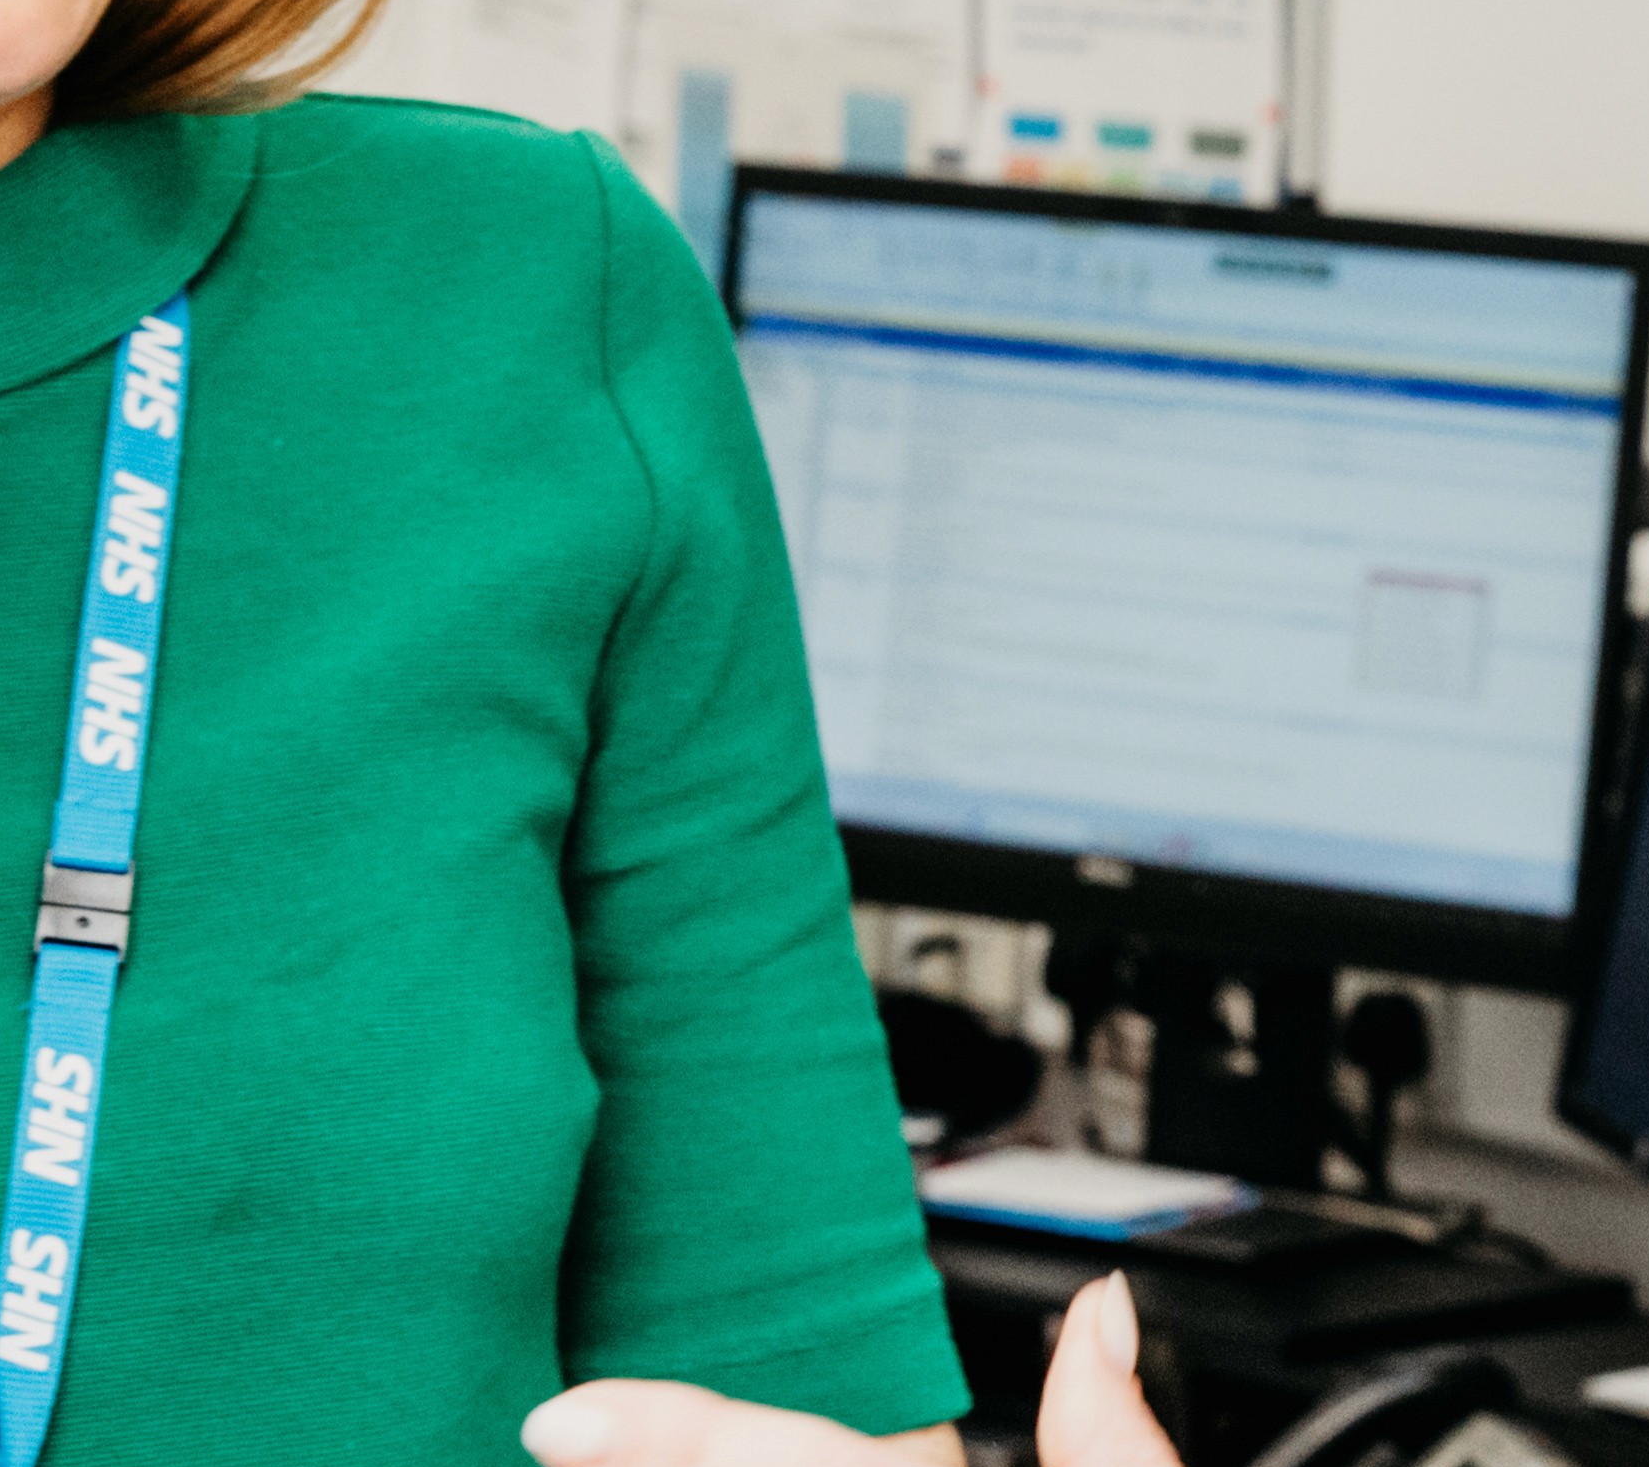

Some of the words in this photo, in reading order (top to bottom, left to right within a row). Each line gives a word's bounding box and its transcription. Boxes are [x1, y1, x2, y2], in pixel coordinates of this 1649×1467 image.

[122, 315, 183, 439] NHS
[100, 470, 168, 604] NHS
[78, 637, 146, 772] NHS
[22, 1047, 93, 1187] NHS
